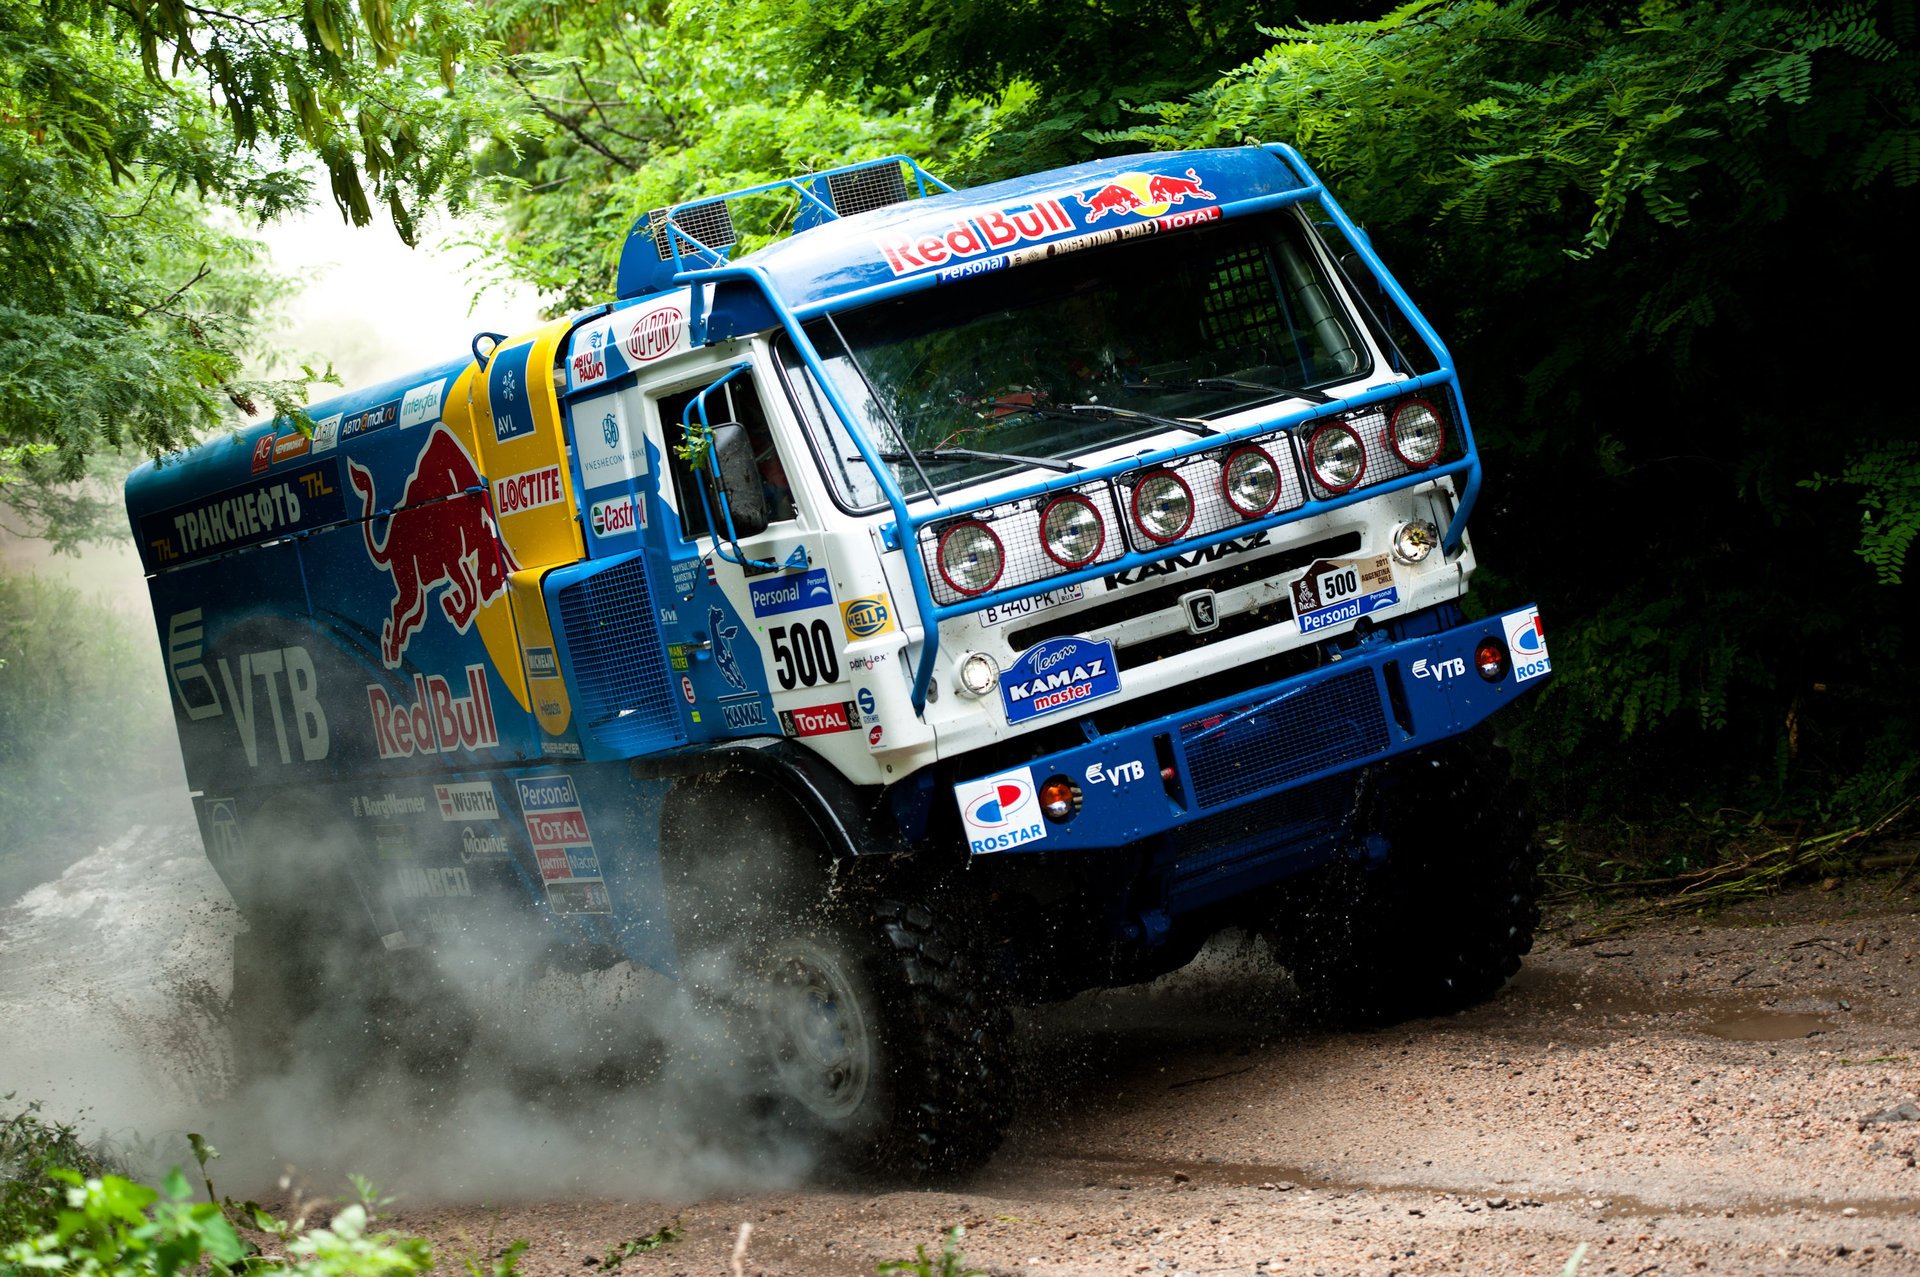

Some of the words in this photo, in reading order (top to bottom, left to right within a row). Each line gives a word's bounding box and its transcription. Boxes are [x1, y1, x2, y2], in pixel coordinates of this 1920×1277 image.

[1164, 209, 1219, 230] TOTAL
[879, 219, 982, 273] Red
[976, 199, 1072, 247] Bull
[1054, 229, 1118, 257] ARGENTINA
[1122, 220, 1153, 241] CHILE
[941, 256, 1006, 282] Personal
[573, 351, 593, 370] АВТО
[579, 361, 604, 383] РАДИО
[498, 414, 517, 436] AVL
[254, 436, 273, 461] AG
[584, 448, 646, 471] VNESHECONBANK
[498, 467, 560, 514] LOCTITE
[174, 482, 301, 555] ТРАНСНЕФТЬ
[671, 559, 700, 574] SHAYSULTANO
[1103, 530, 1272, 591] KAMAZ
[1375, 558, 1389, 568] 2011
[806, 575, 827, 586] Personal
[1324, 570, 1357, 600] 500
[1361, 567, 1391, 582] ARGENTINA
[1378, 575, 1393, 584] CHILE
[752, 581, 800, 608] Personal
[1061, 594, 1075, 602] RUS
[1369, 588, 1393, 601] Personal
[848, 605, 888, 627] HELLA
[1001, 598, 1031, 617] 440
[1303, 599, 1361, 631] Personal
[527, 653, 556, 669] MICHELIN
[768, 618, 840, 691] 500
[1028, 645, 1077, 675] Team
[1009, 659, 1106, 702] KAMAZ
[1430, 657, 1466, 682] VTB
[683, 680, 695, 700] E
[1034, 682, 1093, 711] master
[217, 646, 330, 767] VTB
[368, 675, 437, 757] Red
[428, 666, 498, 750] Bull
[722, 700, 768, 730] KAMAZ
[795, 712, 847, 732] TOTAL
[1106, 759, 1145, 787] VTB
[450, 790, 497, 813] WÜRTH
[520, 778, 575, 806] Personal
[361, 793, 426, 819] BorgWarner
[528, 818, 587, 841] TOTAL
[971, 823, 1042, 854] ROSTAR
[463, 836, 509, 854] MODINE
[540, 857, 568, 870] LOCTITE
[569, 855, 597, 869] Macro
[397, 867, 473, 898] WABCO
